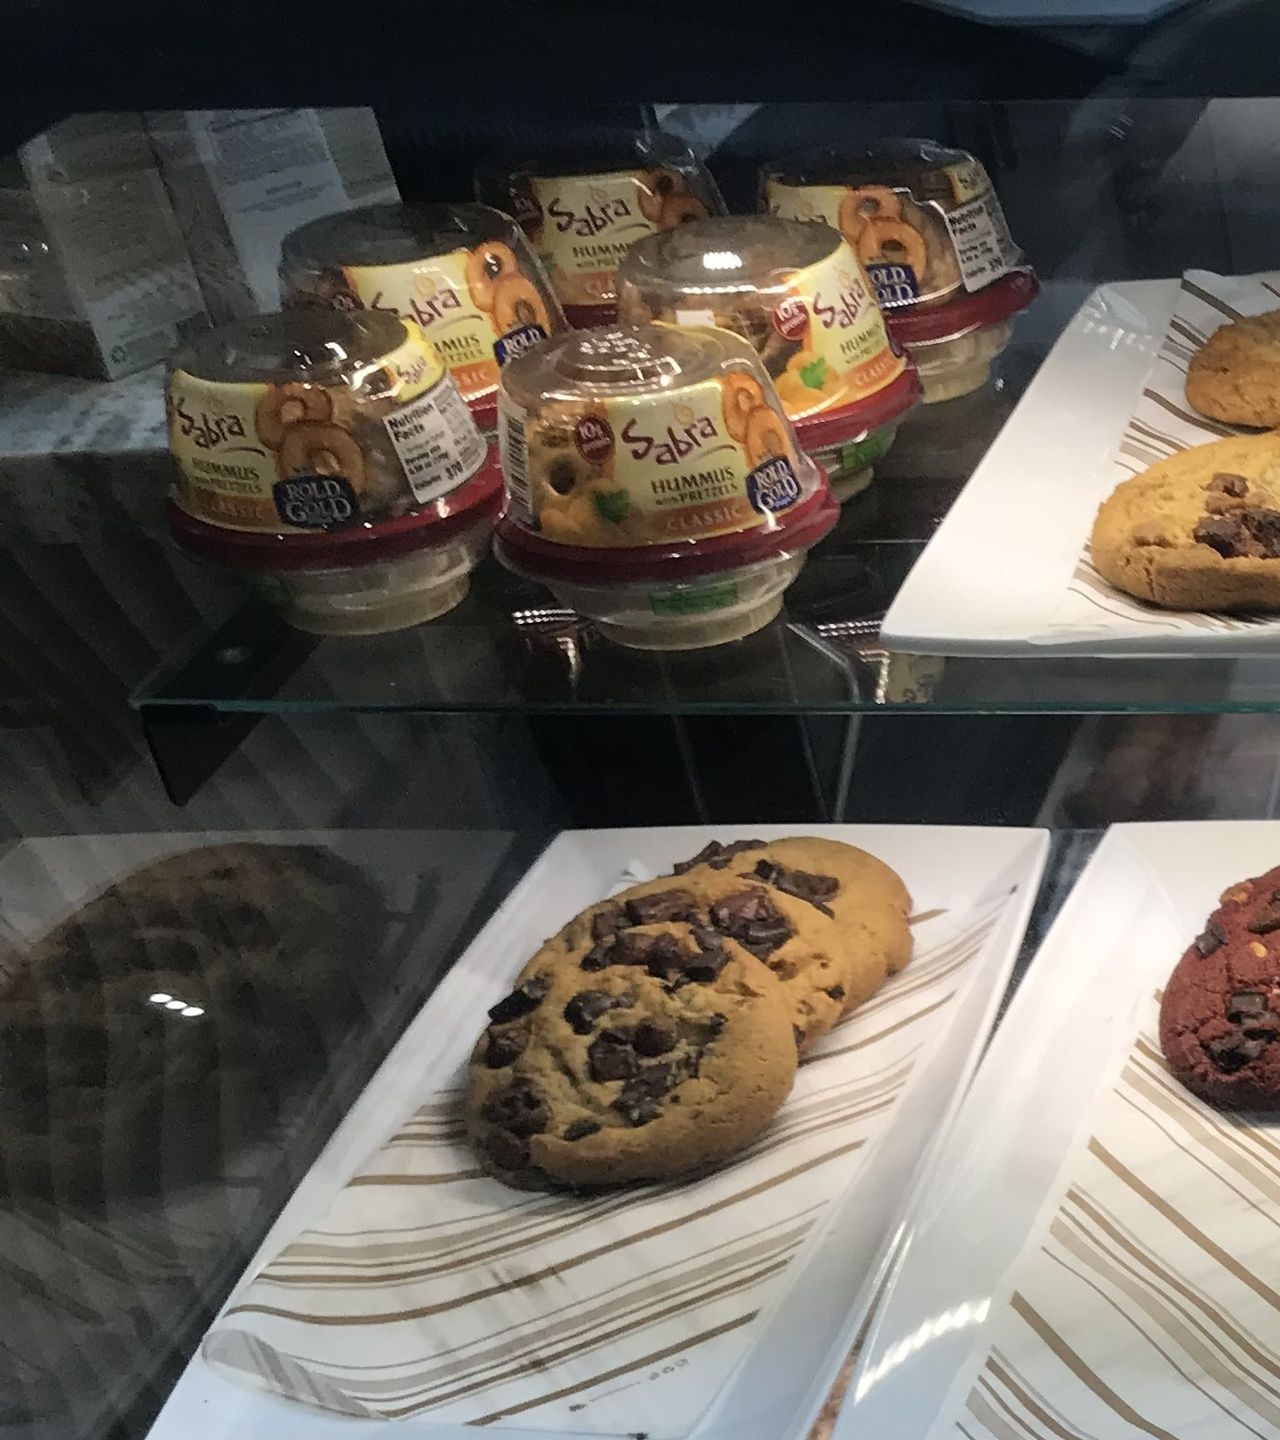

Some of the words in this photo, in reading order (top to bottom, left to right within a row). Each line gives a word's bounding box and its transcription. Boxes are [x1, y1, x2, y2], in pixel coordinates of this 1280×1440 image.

[548, 196, 632, 237] Sabra
[571, 241, 633, 258] HUMM
[871, 266, 910, 286] OLD
[812, 277, 866, 330] Sabra
[878, 282, 915, 301] OLD
[432, 334, 481, 355] MUS
[176, 397, 245, 449] Sabra
[620, 415, 719, 466] Sabra
[650, 465, 736, 495] HUMMUS
[755, 458, 791, 491] ROLD
[284, 480, 342, 501] ROLD
[678, 481, 739, 504] PRETZELS
[757, 473, 802, 509] GOLD
[285, 496, 353, 523] GOLD
[664, 505, 744, 533] CLASSIC
